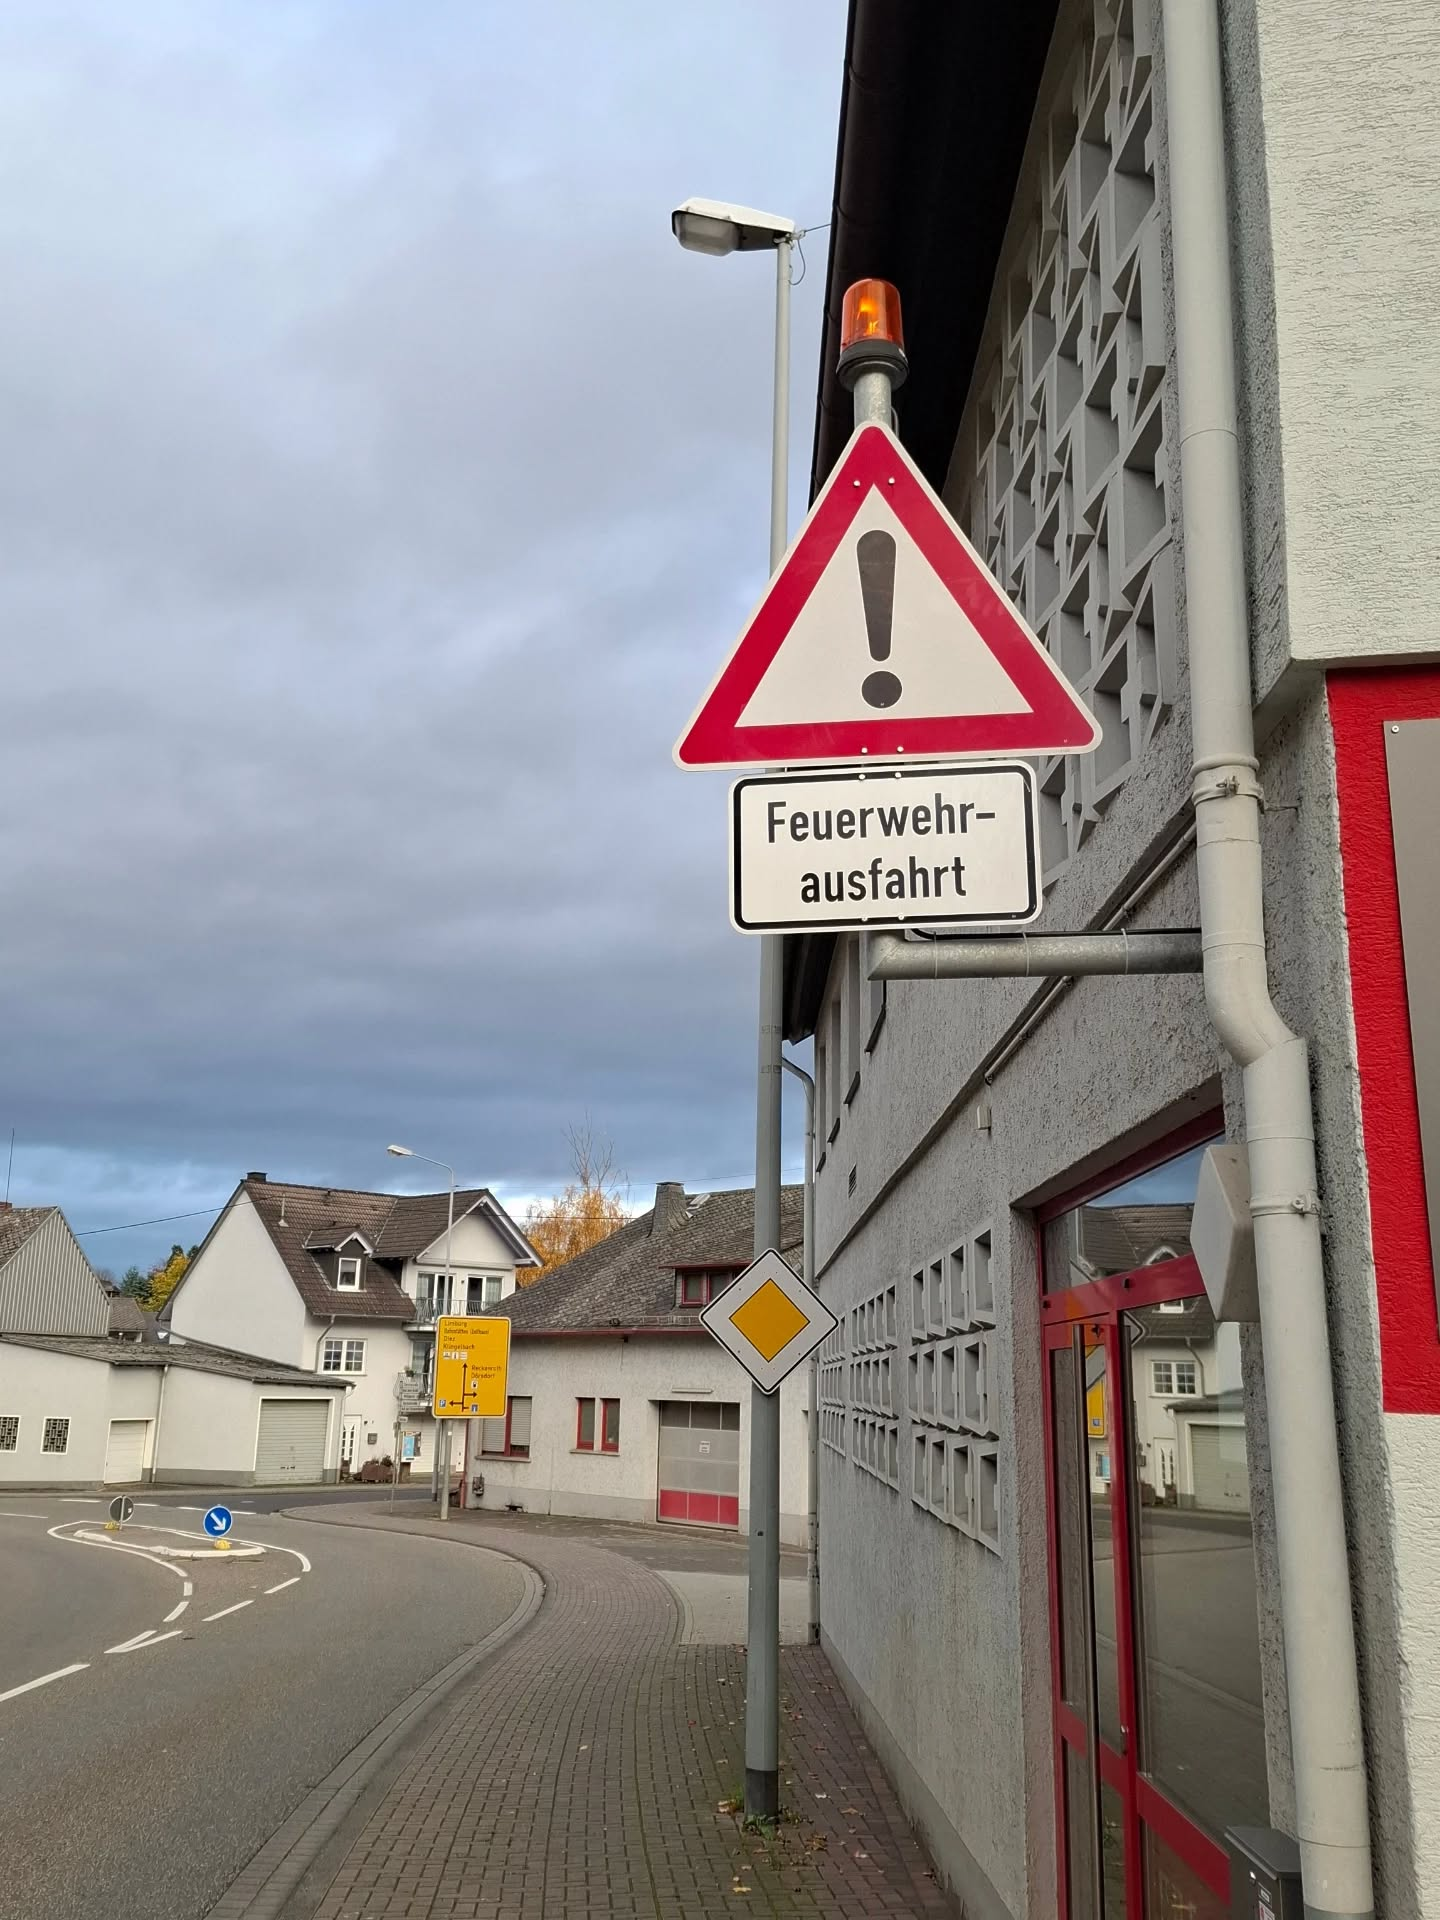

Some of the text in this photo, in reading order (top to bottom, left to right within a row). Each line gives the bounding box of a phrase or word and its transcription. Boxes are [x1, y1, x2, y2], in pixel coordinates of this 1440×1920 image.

[767, 792, 996, 844] Feuerwehr-
[800, 855, 967, 903] ausfahrt
[444, 1320, 468, 1328] Limburg
